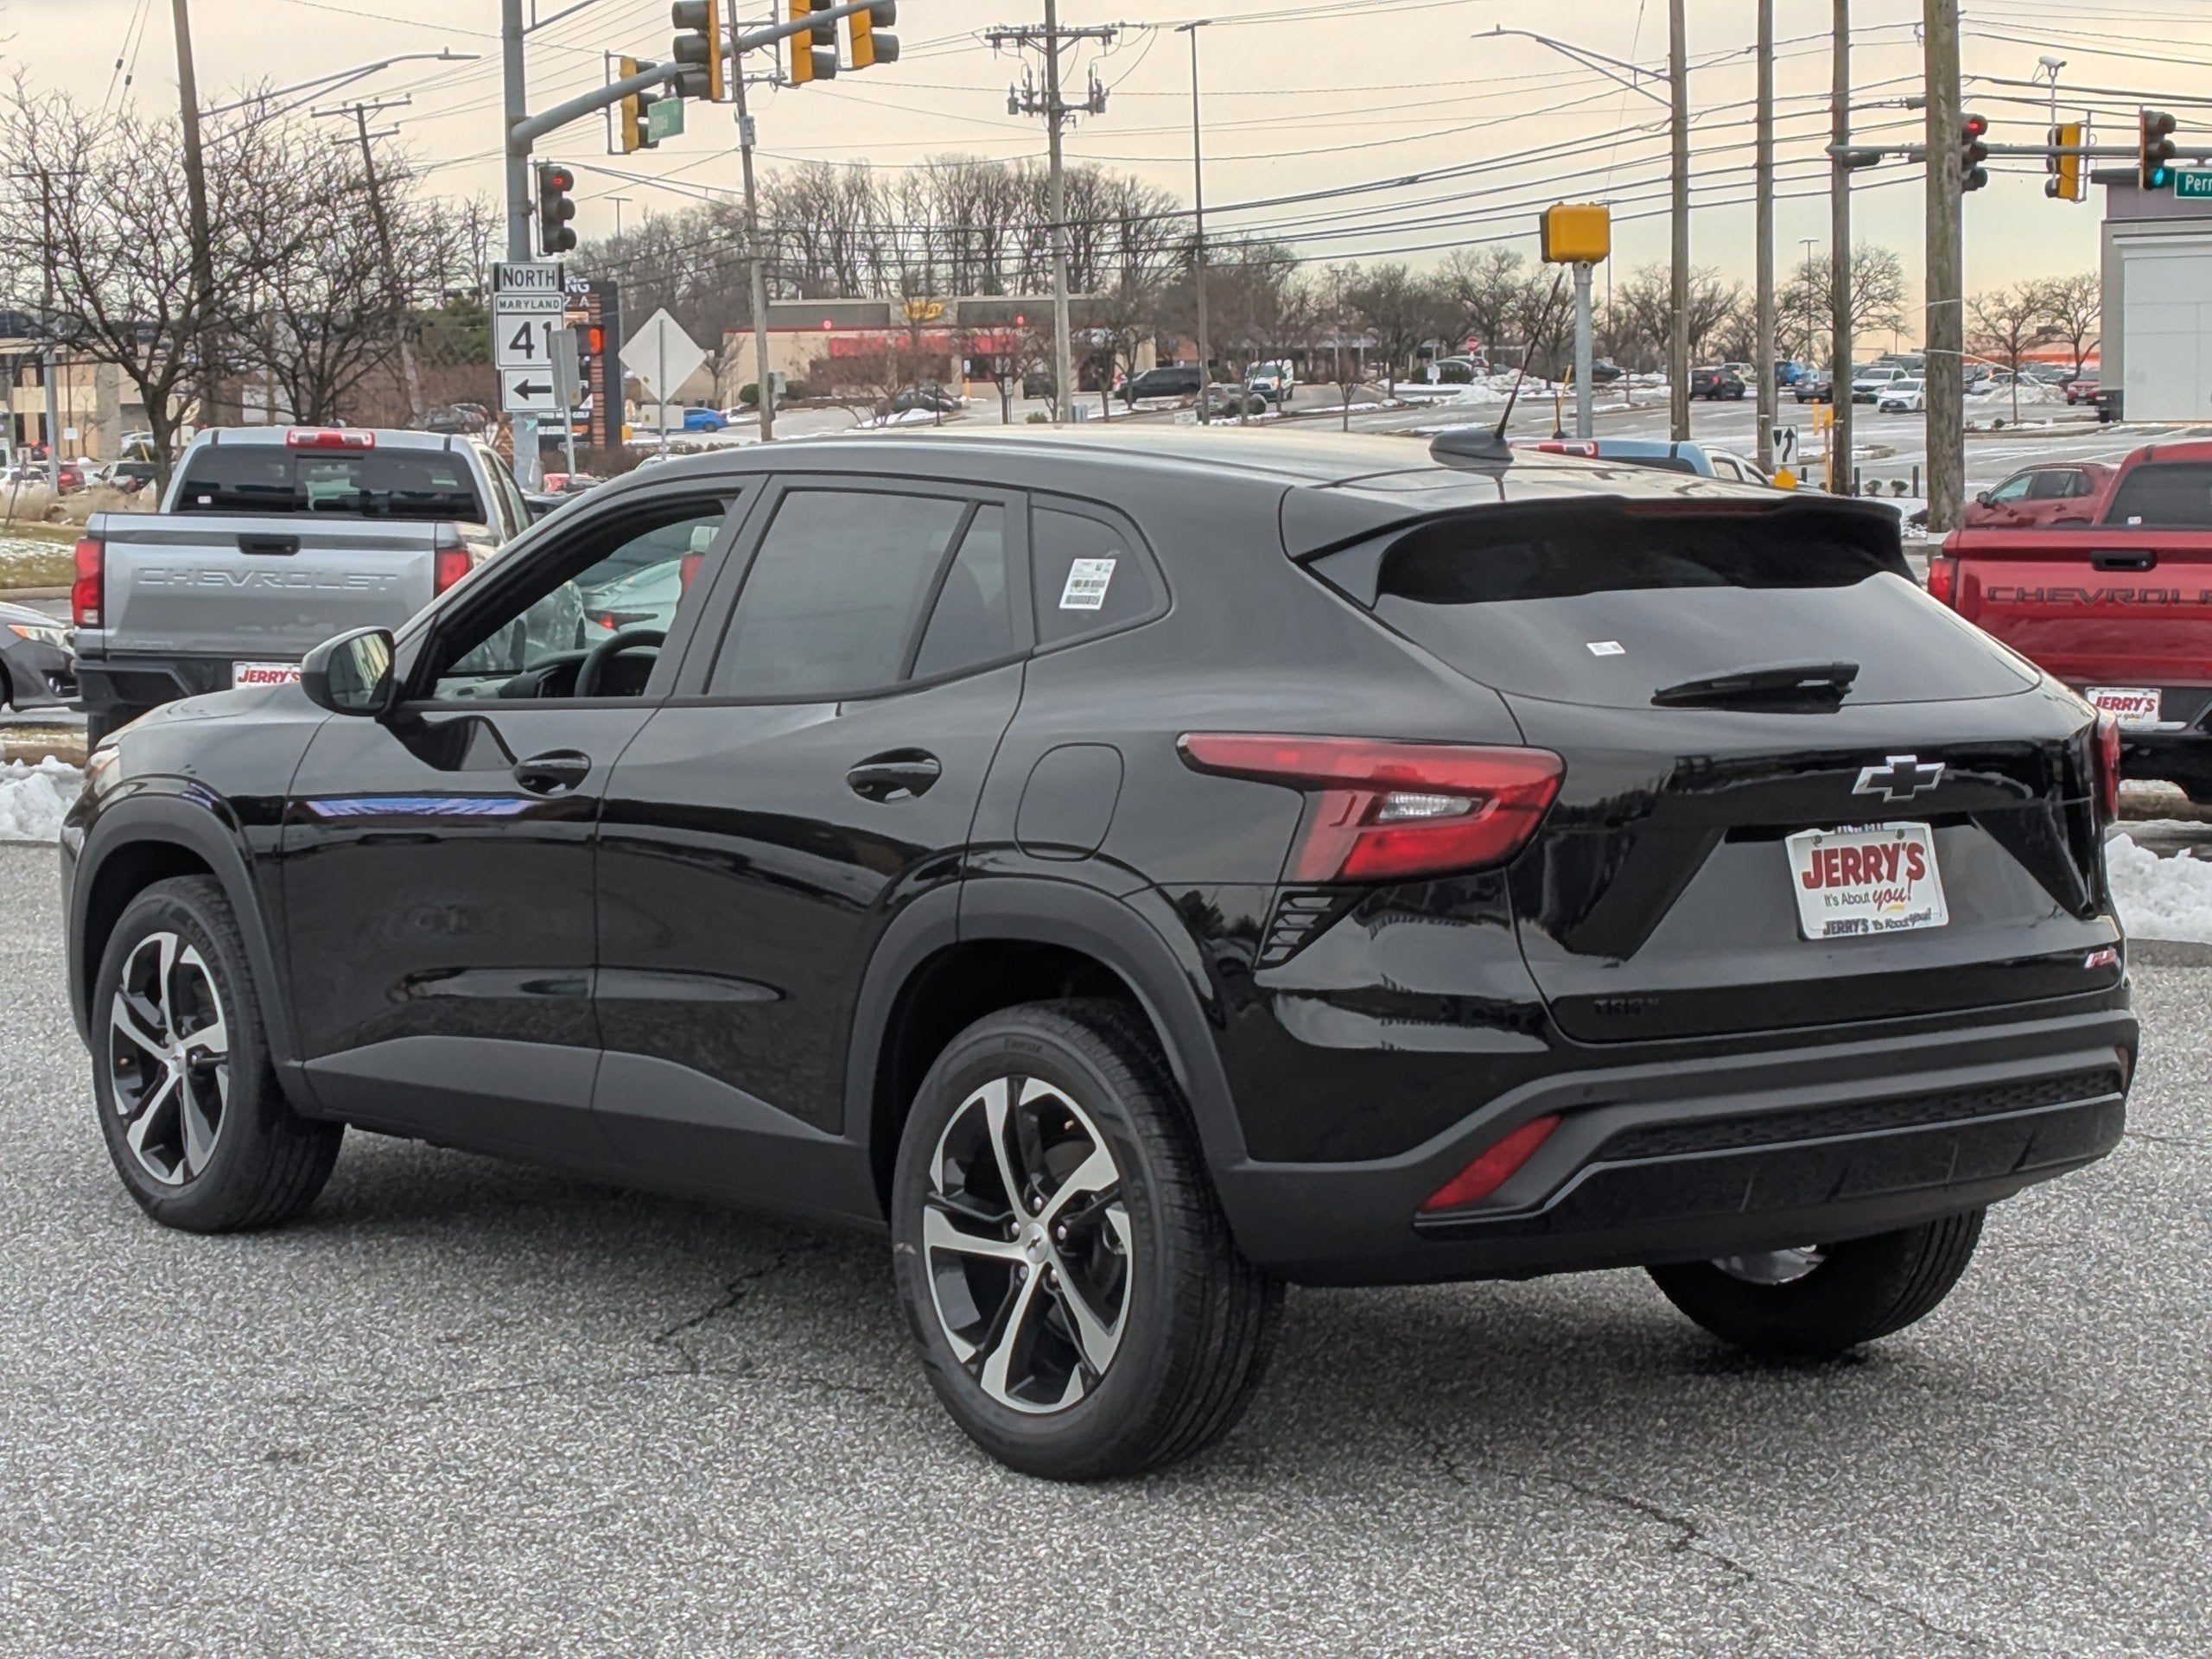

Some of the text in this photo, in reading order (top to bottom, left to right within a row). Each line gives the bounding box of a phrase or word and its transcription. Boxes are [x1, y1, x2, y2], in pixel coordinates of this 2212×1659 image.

[502, 268, 556, 287] NORTH
[499, 299, 560, 309] MARYLAND
[508, 321, 552, 359] 41
[138, 567, 397, 590] CHEVROLET
[238, 669, 301, 684] JERRY'S
[1802, 842, 1926, 890] JERRY'S
[1824, 880, 1912, 912] It's About you!
